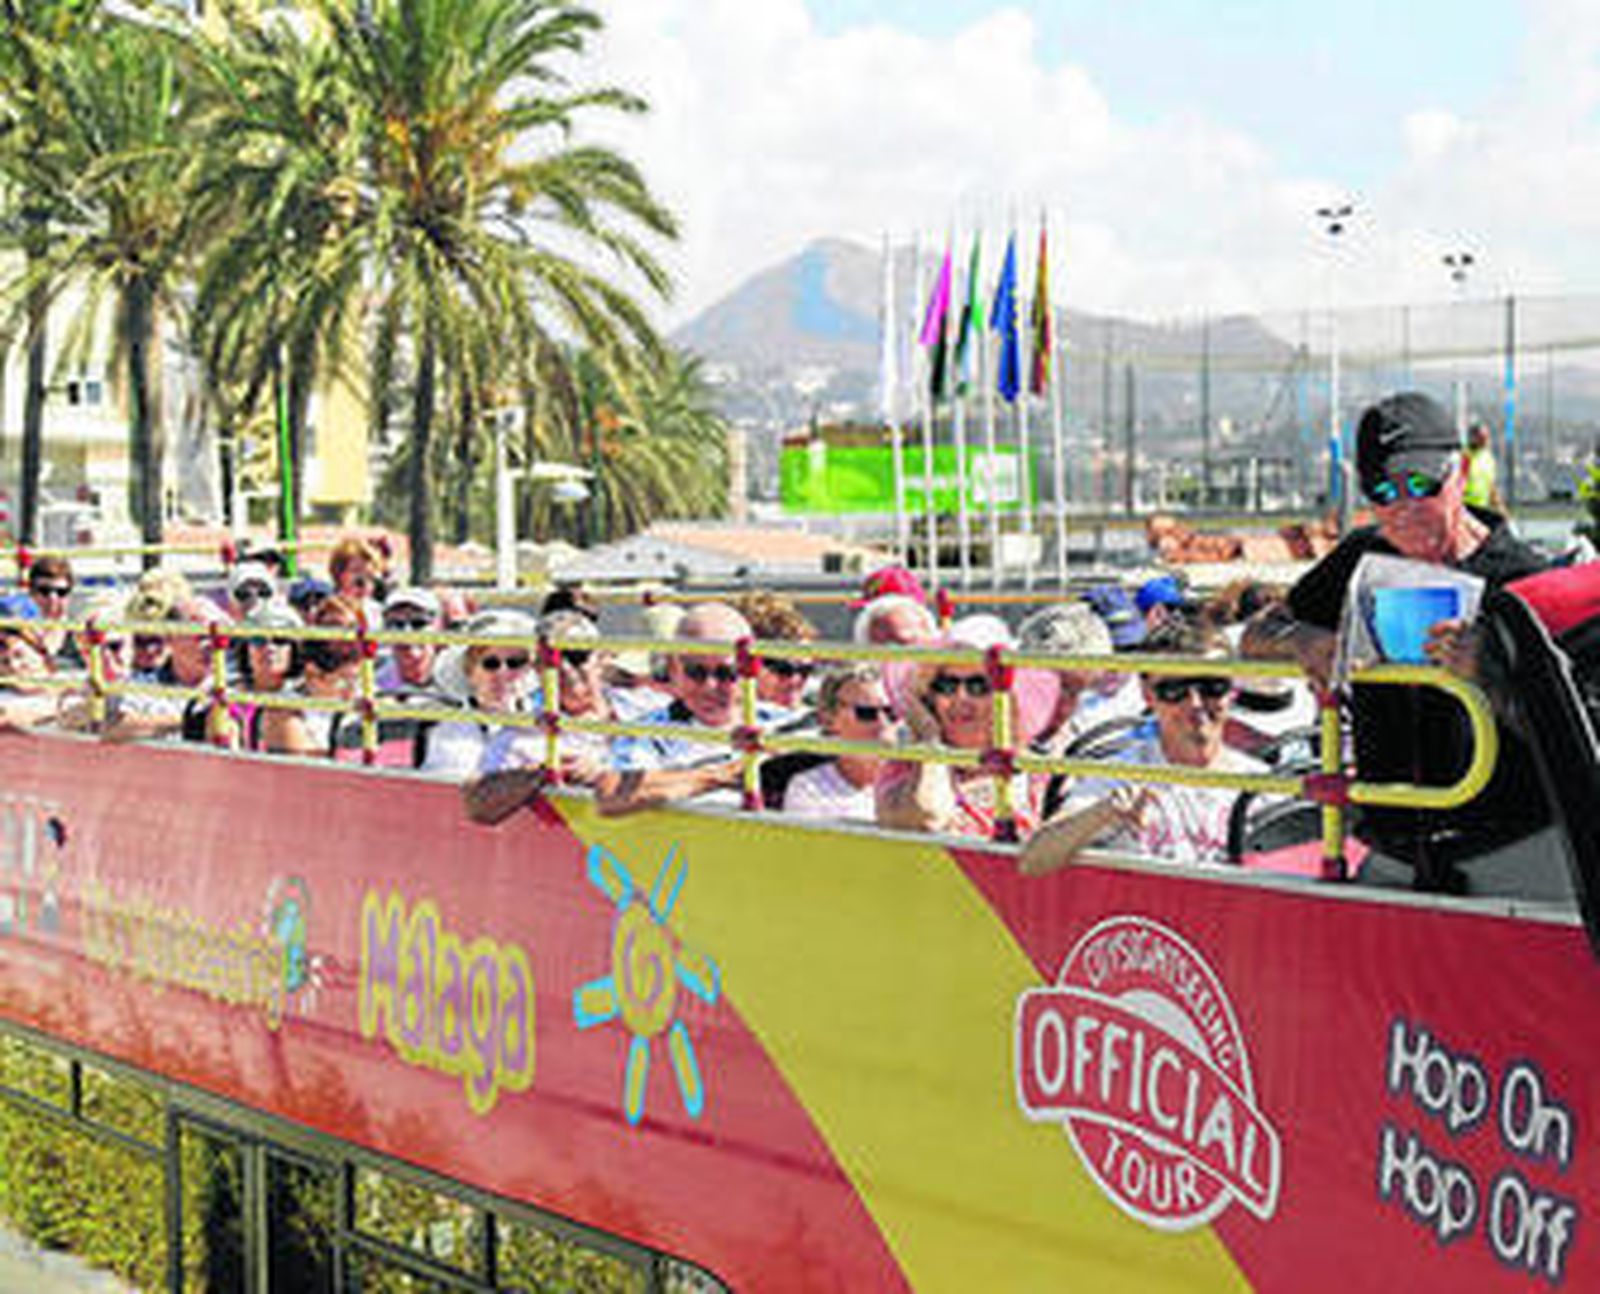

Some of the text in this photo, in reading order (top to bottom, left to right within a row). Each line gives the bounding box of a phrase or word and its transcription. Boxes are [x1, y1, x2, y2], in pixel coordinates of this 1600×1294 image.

[1033, 1009, 1263, 1197] OFFICIAL
[1390, 1022, 1569, 1162] Hop On
[1104, 1132, 1204, 1208] TOUR
[1381, 1128, 1574, 1276] Hop Off
